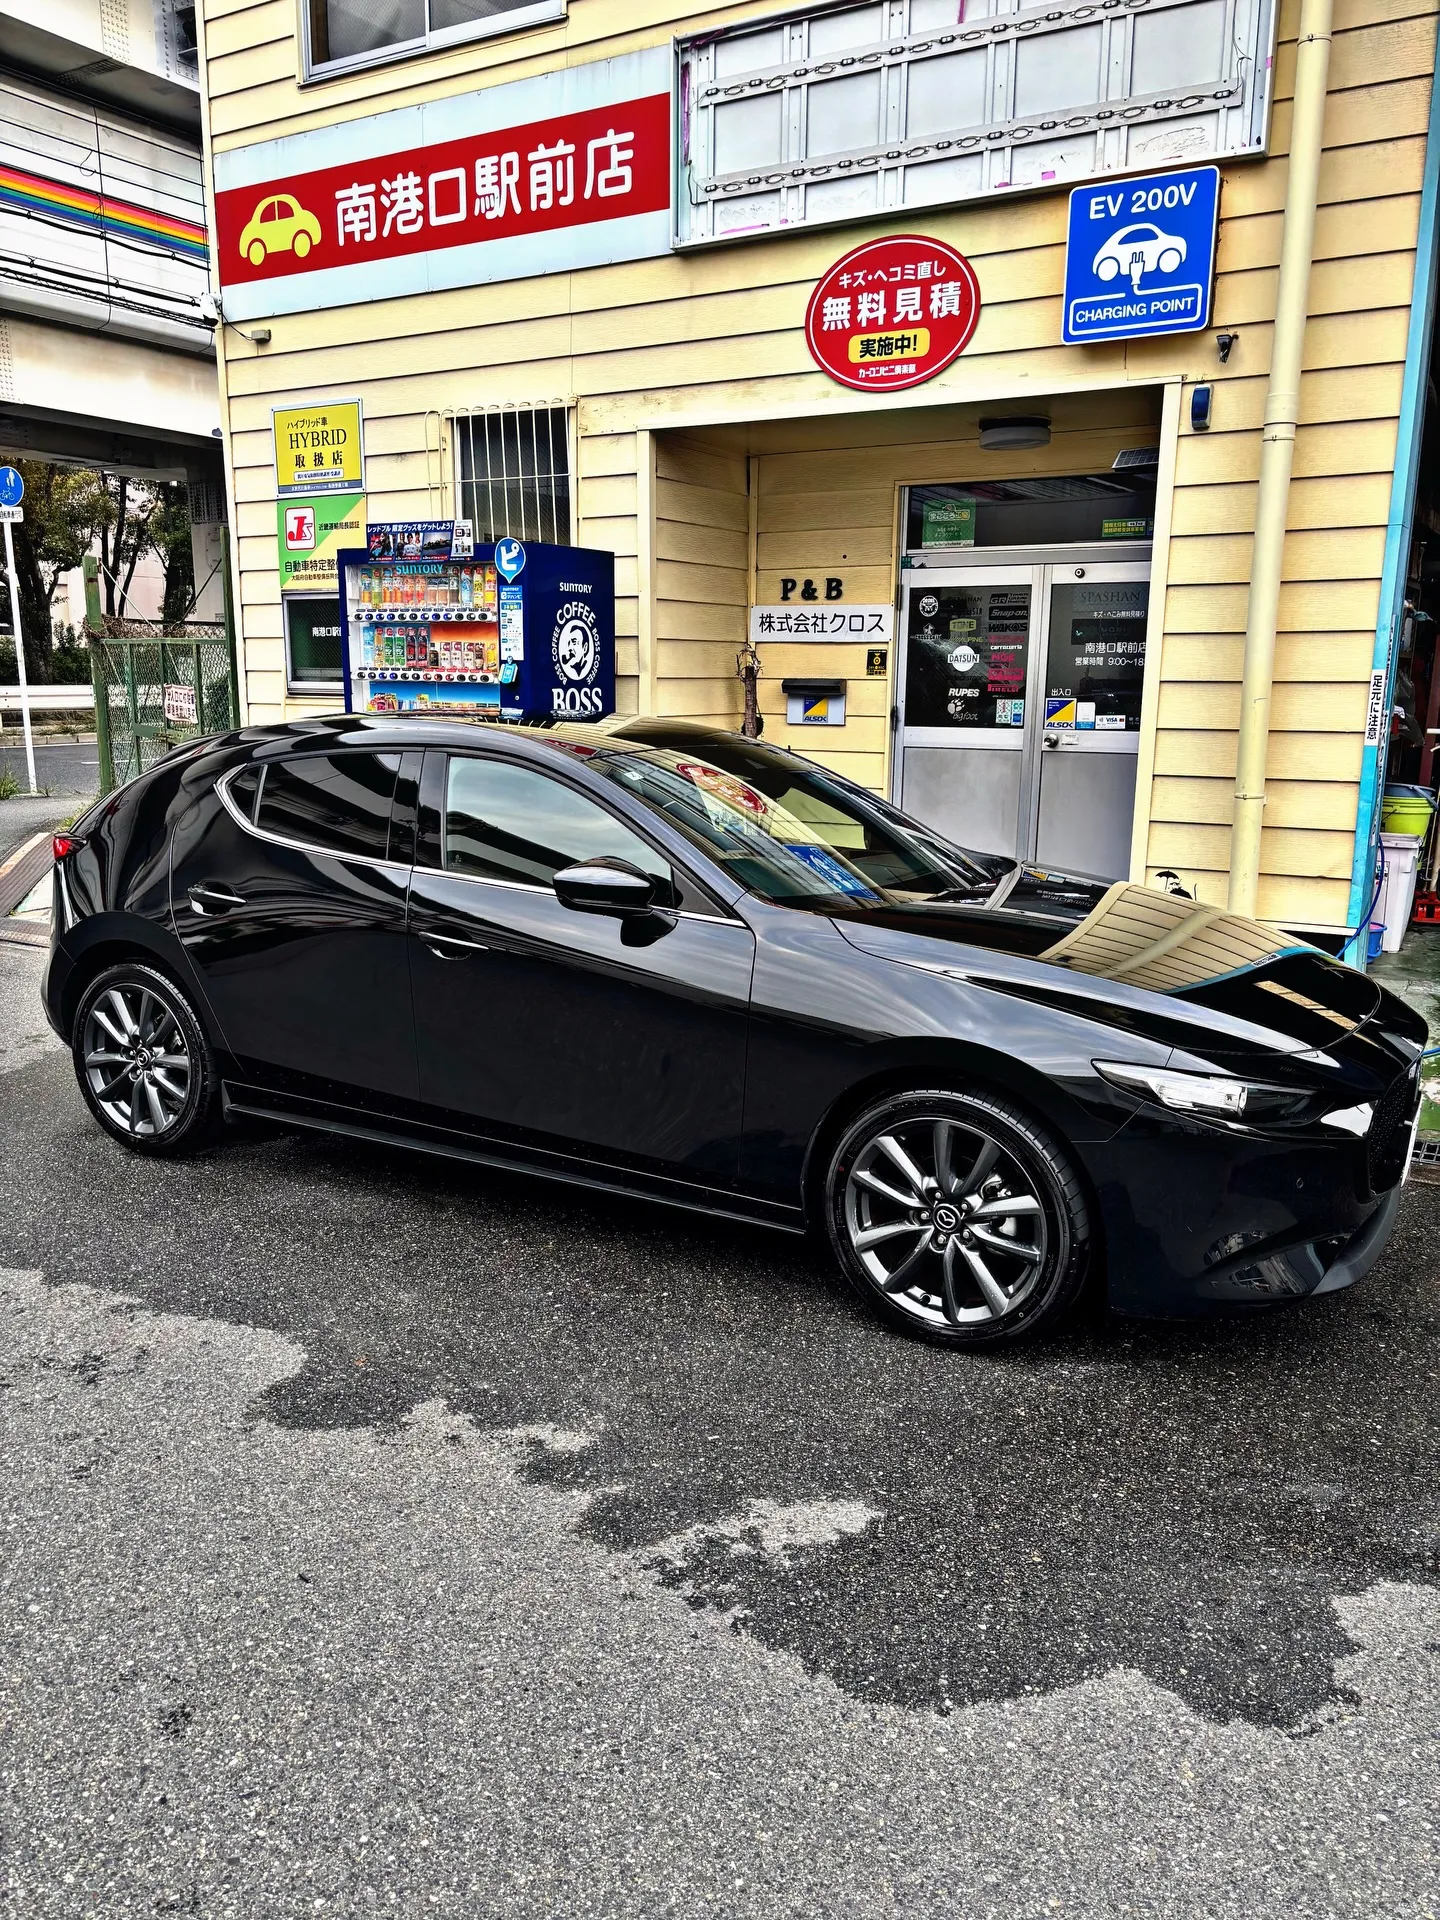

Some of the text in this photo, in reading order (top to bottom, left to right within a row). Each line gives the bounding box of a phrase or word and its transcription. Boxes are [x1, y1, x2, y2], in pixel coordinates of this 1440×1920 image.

[335, 128, 635, 247] 南港口駅前店
[1089, 181, 1197, 220] EV 200V
[839, 260, 946, 289] キズ・ヘコミ直し
[822, 281, 962, 332] 無料見積
[1075, 297, 1195, 323] CHARGING POINT
[859, 334, 918, 359] 実施中!
[286, 416, 328, 429] ハイブリッド車
[289, 429, 347, 449] HYBRID
[295, 450, 343, 468] 取扱店
[367, 525, 391, 533] レッドブル
[285, 559, 338, 573] 自動車特定整
[500, 542, 520, 571] ピ
[780, 577, 843, 601] P & B
[1080, 591, 1141, 603] SPASHAN
[556, 601, 596, 628] COFFEE
[758, 612, 884, 634] 株式会社クロス
[949, 654, 978, 663] DATSUN
[1085, 642, 1146, 654] 南港口駅前店
[1075, 657, 1104, 666] 営業時間
[551, 687, 603, 712] BOSS
[948, 688, 980, 697] RUPES
[1051, 688, 1072, 696] 出入口
[1366, 675, 1383, 740] 足元に注意
